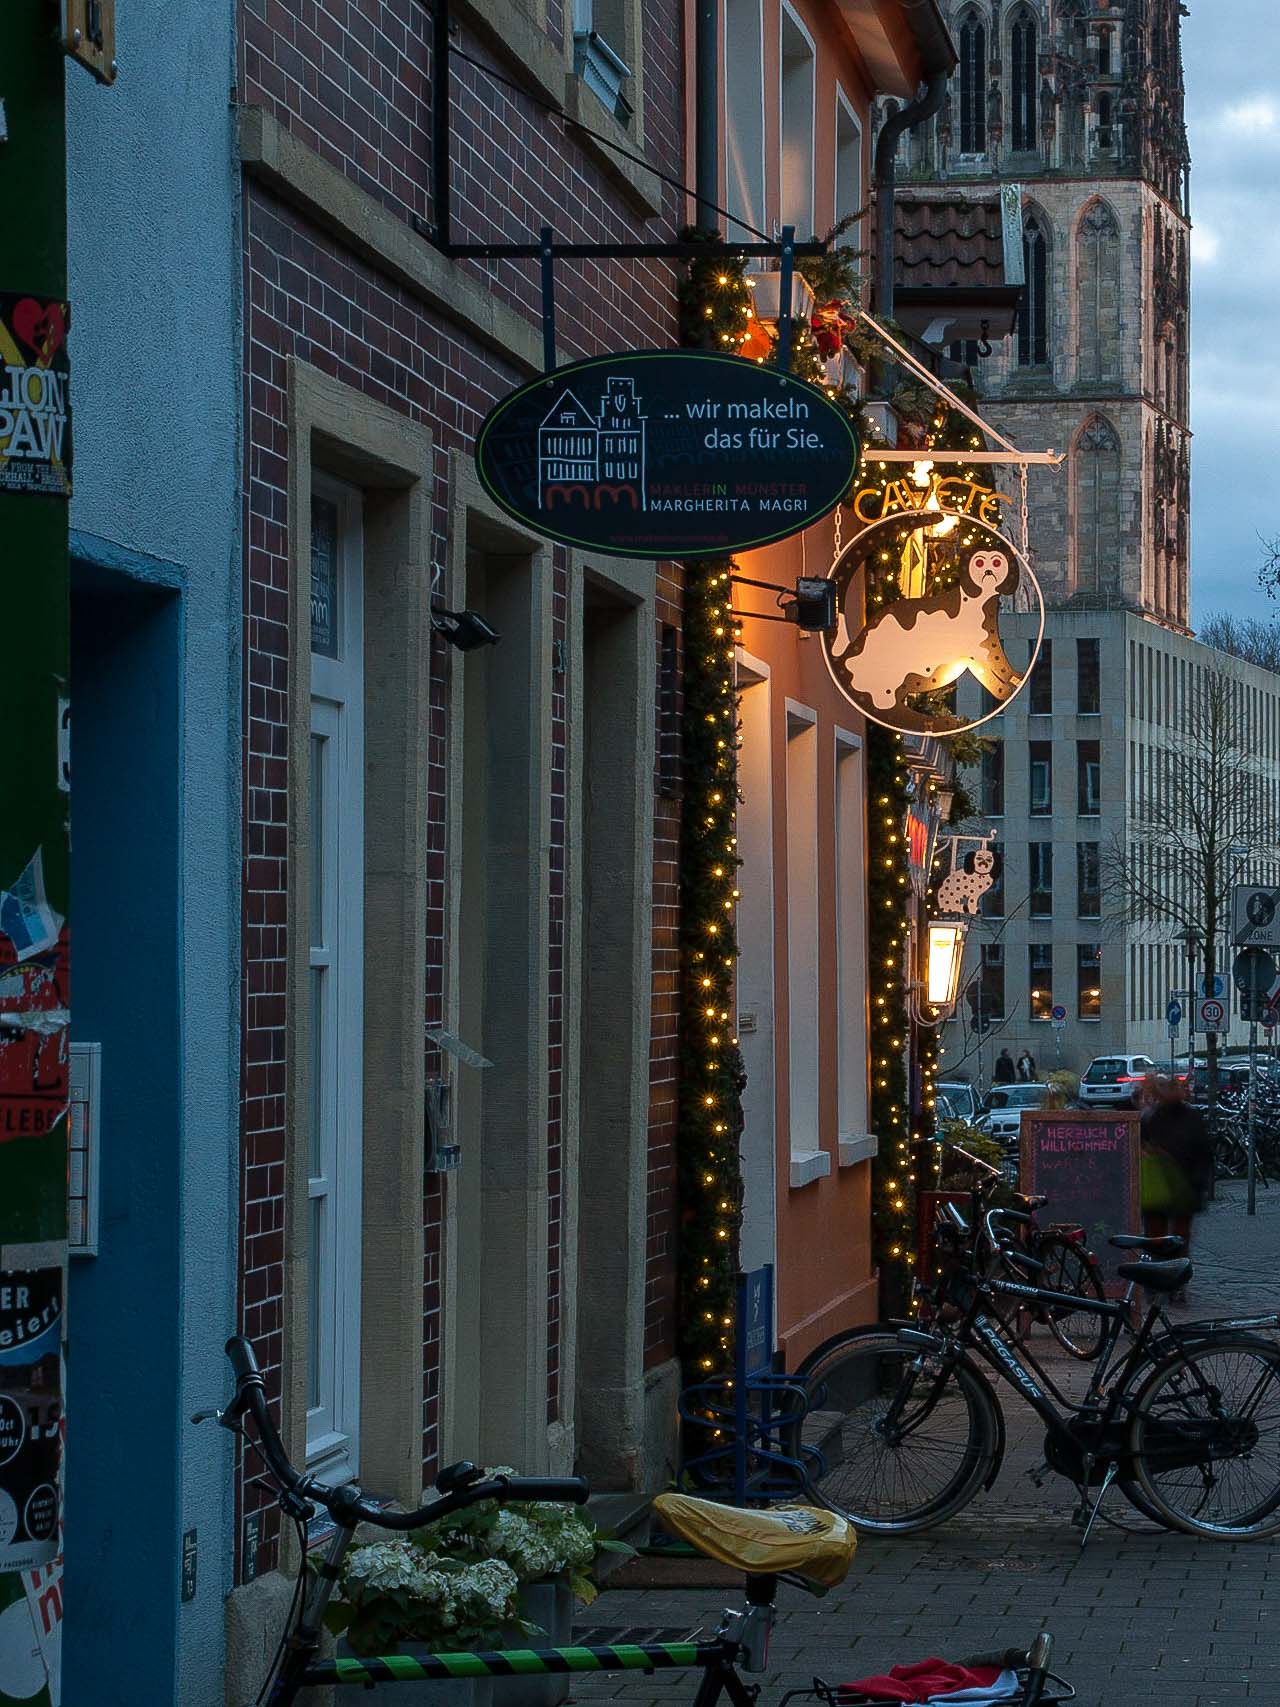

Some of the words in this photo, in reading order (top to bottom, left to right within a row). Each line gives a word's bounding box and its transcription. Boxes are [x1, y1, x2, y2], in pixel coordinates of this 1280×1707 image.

[685, 398, 724, 420] wir
[727, 396, 809, 420] makeln
[703, 428, 743, 449] das
[747, 427, 779, 450] für
[786, 428, 825, 450] Sie.
[650, 482, 727, 497] MAKLERIN
[736, 480, 809, 497] MÜNSTER
[650, 499, 751, 513] MARGHERITA
[758, 499, 809, 513] MAGRI
[853, 475, 1014, 531] CAVETE
[1206, 1006, 1219, 1018] 30
[1039, 1138, 1118, 1153] WILLKOMMEN
[1, 1286, 31, 1311] ER
[981, 1326, 1042, 1400] PEGASUS
